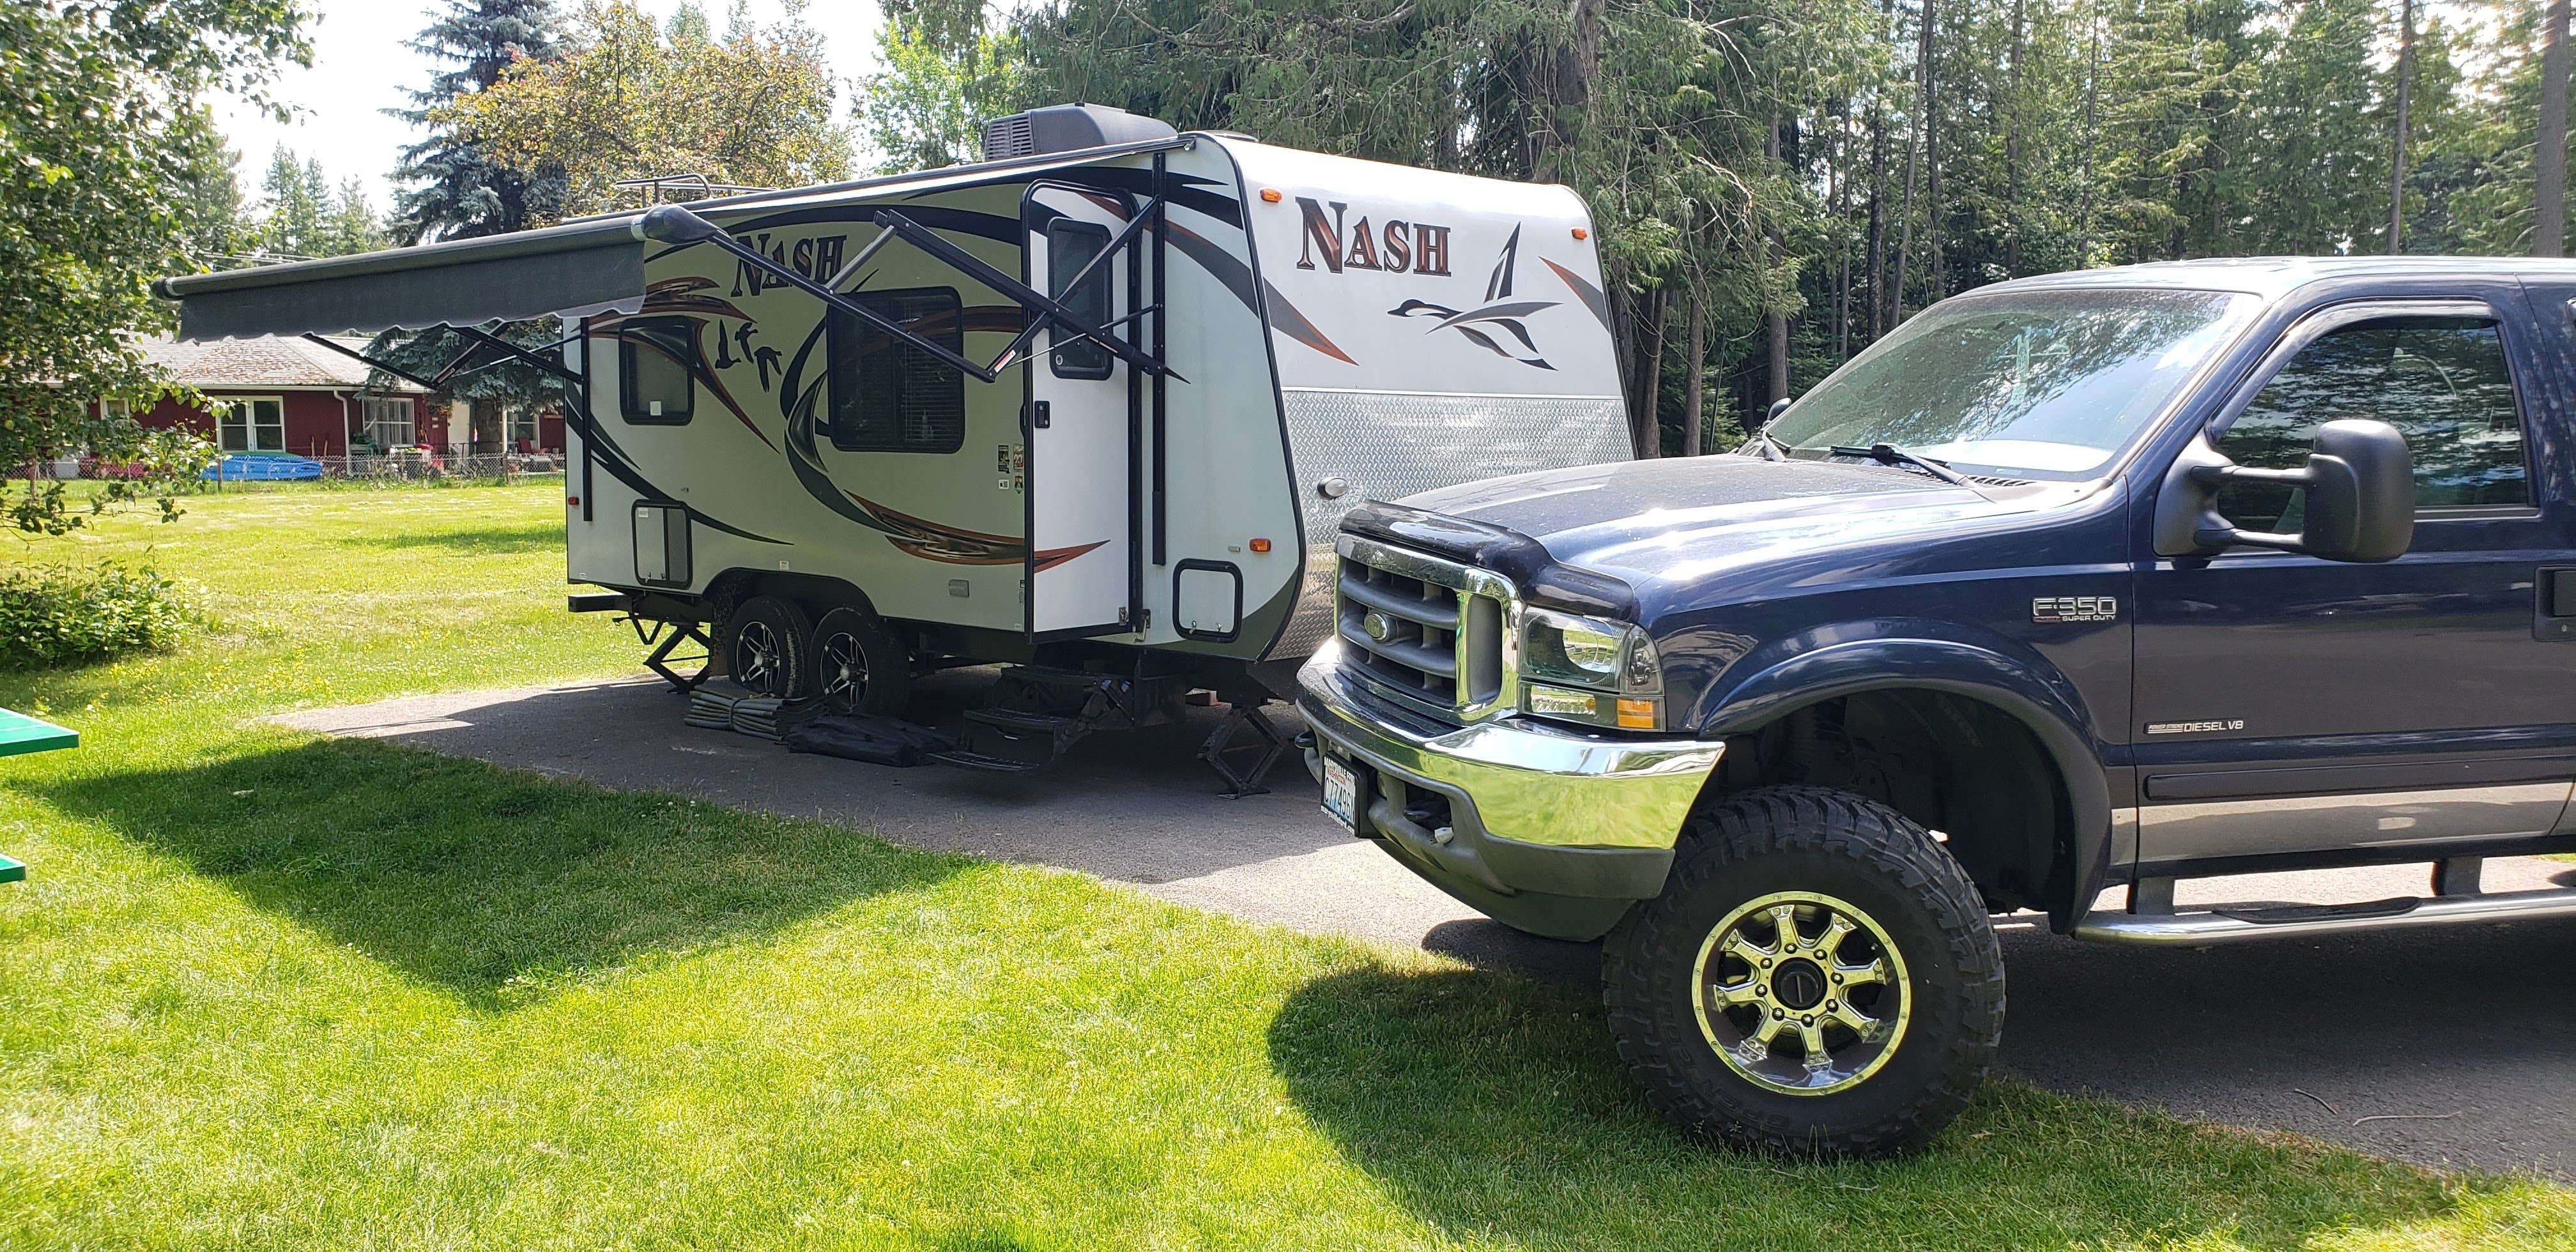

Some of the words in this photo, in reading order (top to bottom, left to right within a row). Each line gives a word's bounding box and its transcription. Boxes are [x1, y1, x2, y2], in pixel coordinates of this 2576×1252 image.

[1295, 196, 1452, 277] NASH
[730, 233, 847, 298] NASH
[2033, 597, 2116, 616] F-350
[2184, 722, 2227, 732] DIESEL
[2227, 720, 2244, 730] V8
